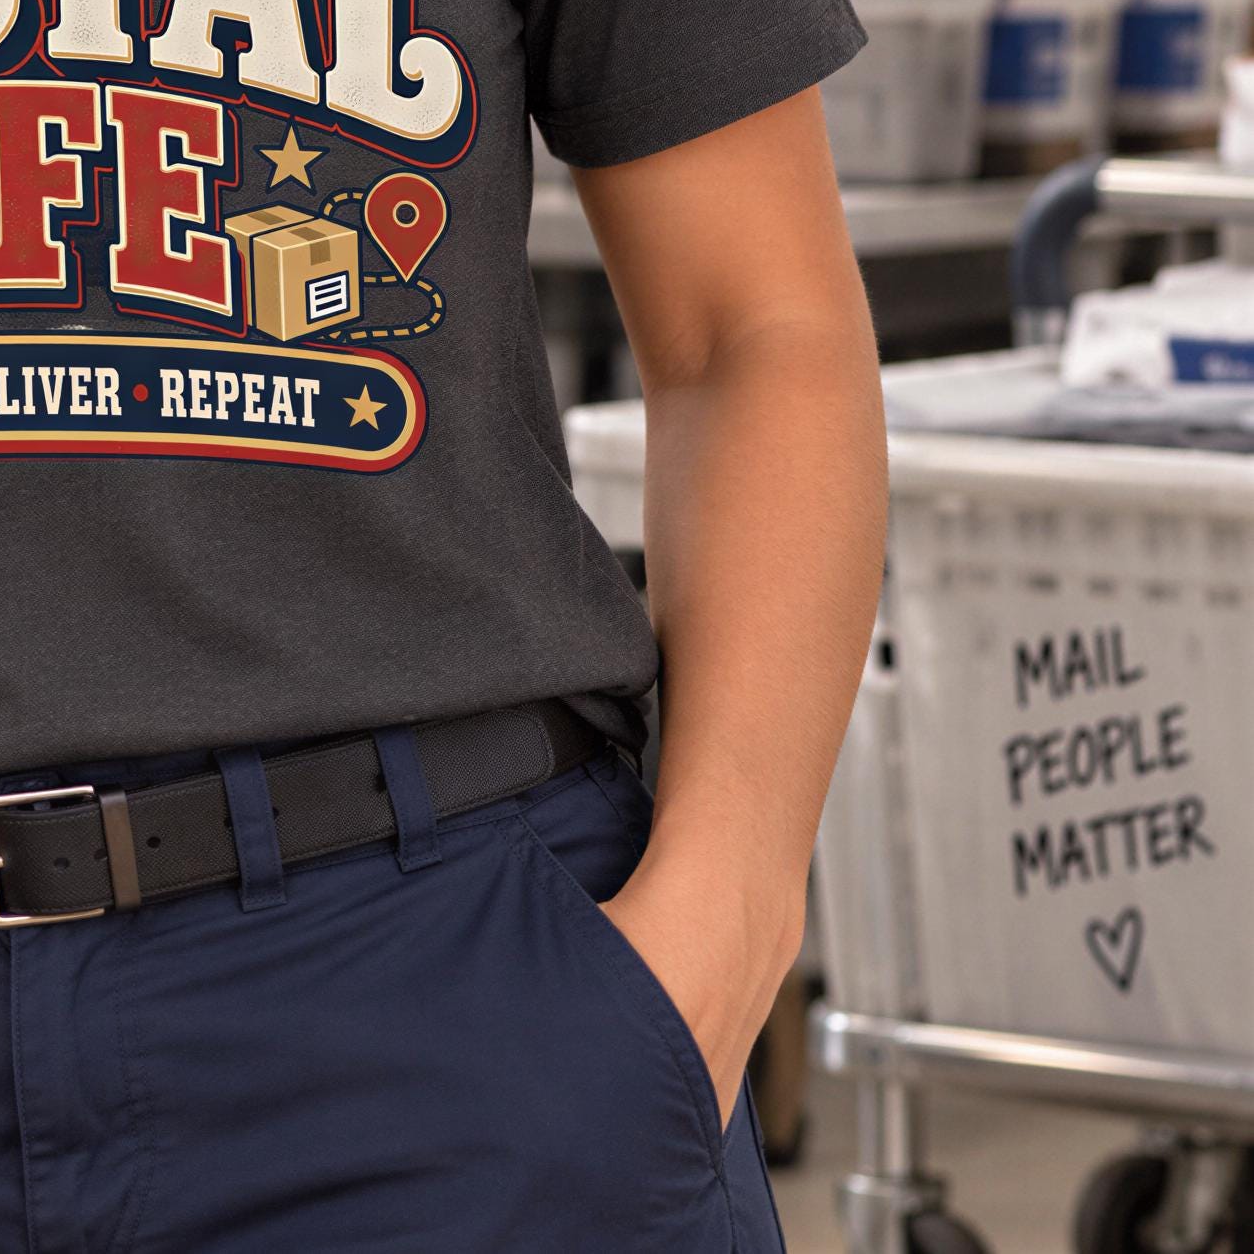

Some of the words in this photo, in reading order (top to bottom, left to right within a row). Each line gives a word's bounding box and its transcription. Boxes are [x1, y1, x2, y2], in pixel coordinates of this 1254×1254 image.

[159, 368, 321, 428] REPEAT
[1014, 625, 1146, 707] MAIL
[1004, 704, 1191, 805] PEOPLE
[1012, 797, 1214, 895] MATTER
